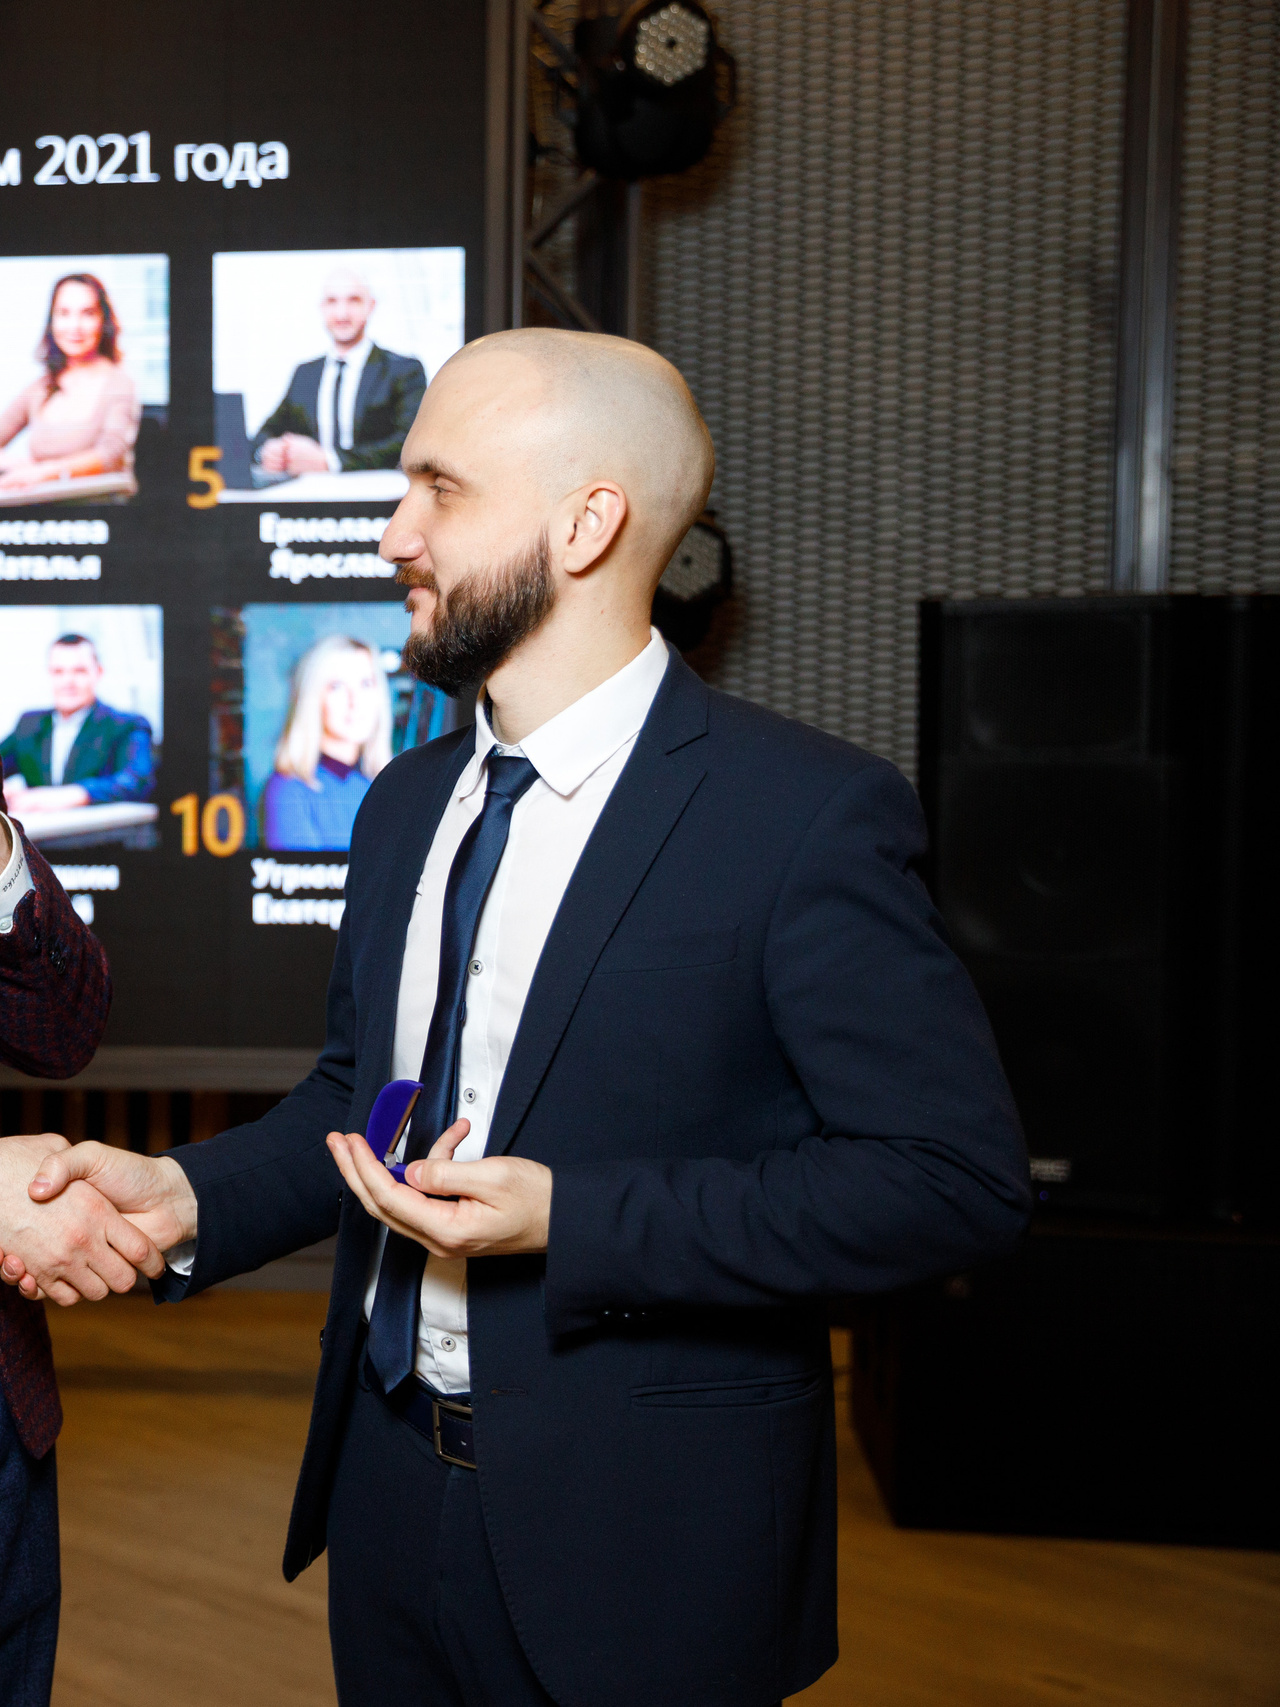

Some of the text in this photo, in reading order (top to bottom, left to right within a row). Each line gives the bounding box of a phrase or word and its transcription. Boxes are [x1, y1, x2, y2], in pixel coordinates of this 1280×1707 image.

[33, 131, 160, 186] 2021
[173, 140, 290, 189] года
[187, 446, 225, 509] 5
[259, 512, 392, 548] Ермолае
[170, 792, 245, 857] 10
[251, 857, 350, 896] Угрюм
[251, 892, 347, 931] Екатер
